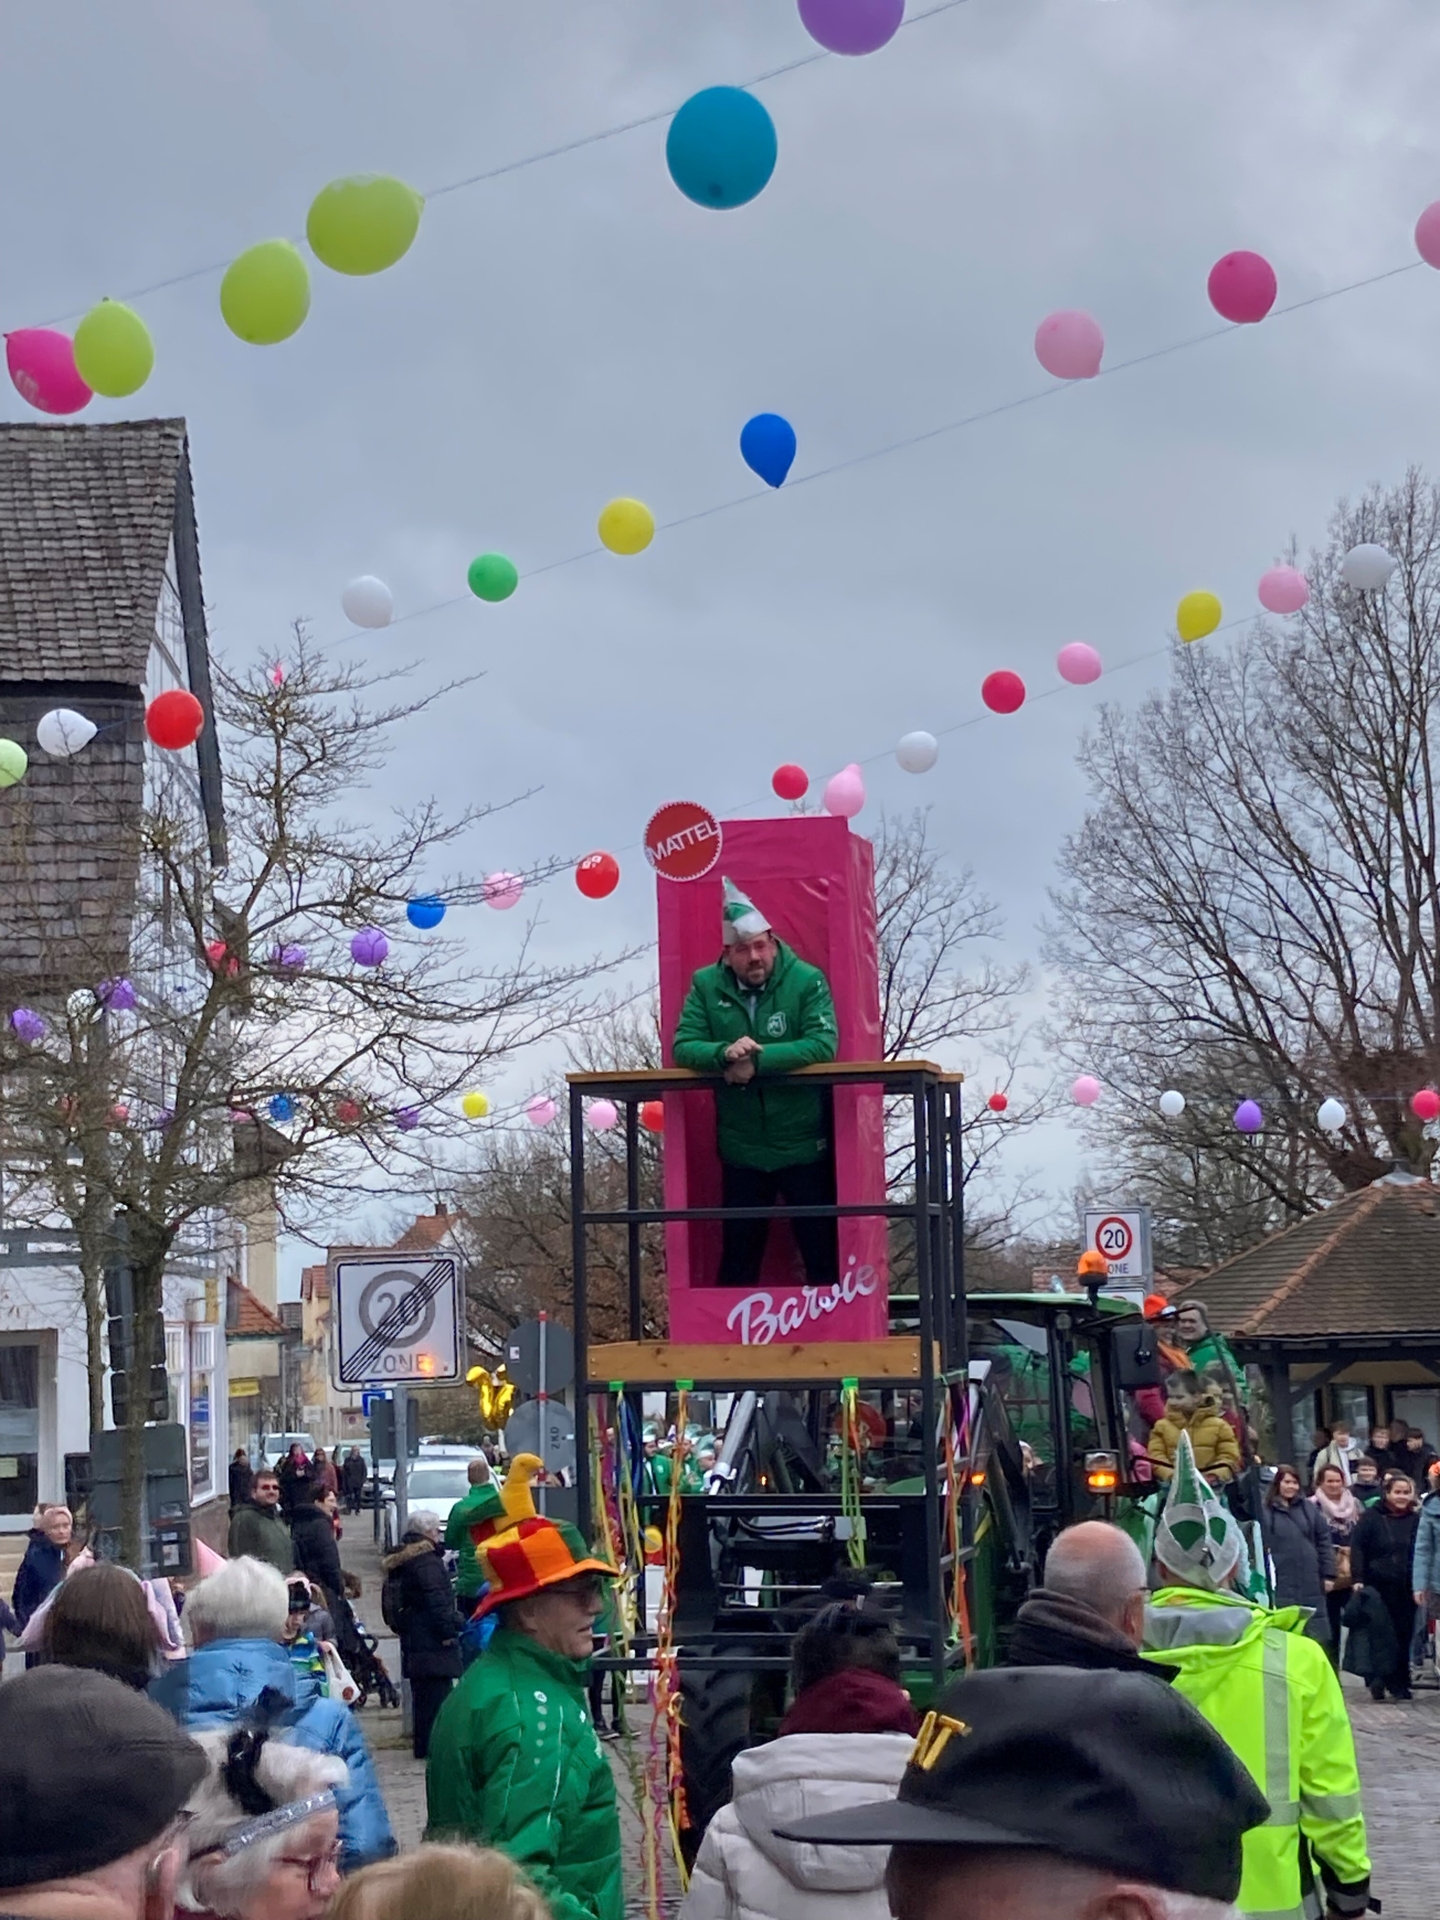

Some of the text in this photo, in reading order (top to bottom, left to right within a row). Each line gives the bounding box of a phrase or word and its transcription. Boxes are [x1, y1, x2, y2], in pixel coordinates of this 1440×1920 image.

[646, 820, 720, 866] MATTEL
[1103, 1229, 1125, 1249] 20
[1107, 1263, 1130, 1274] ONE
